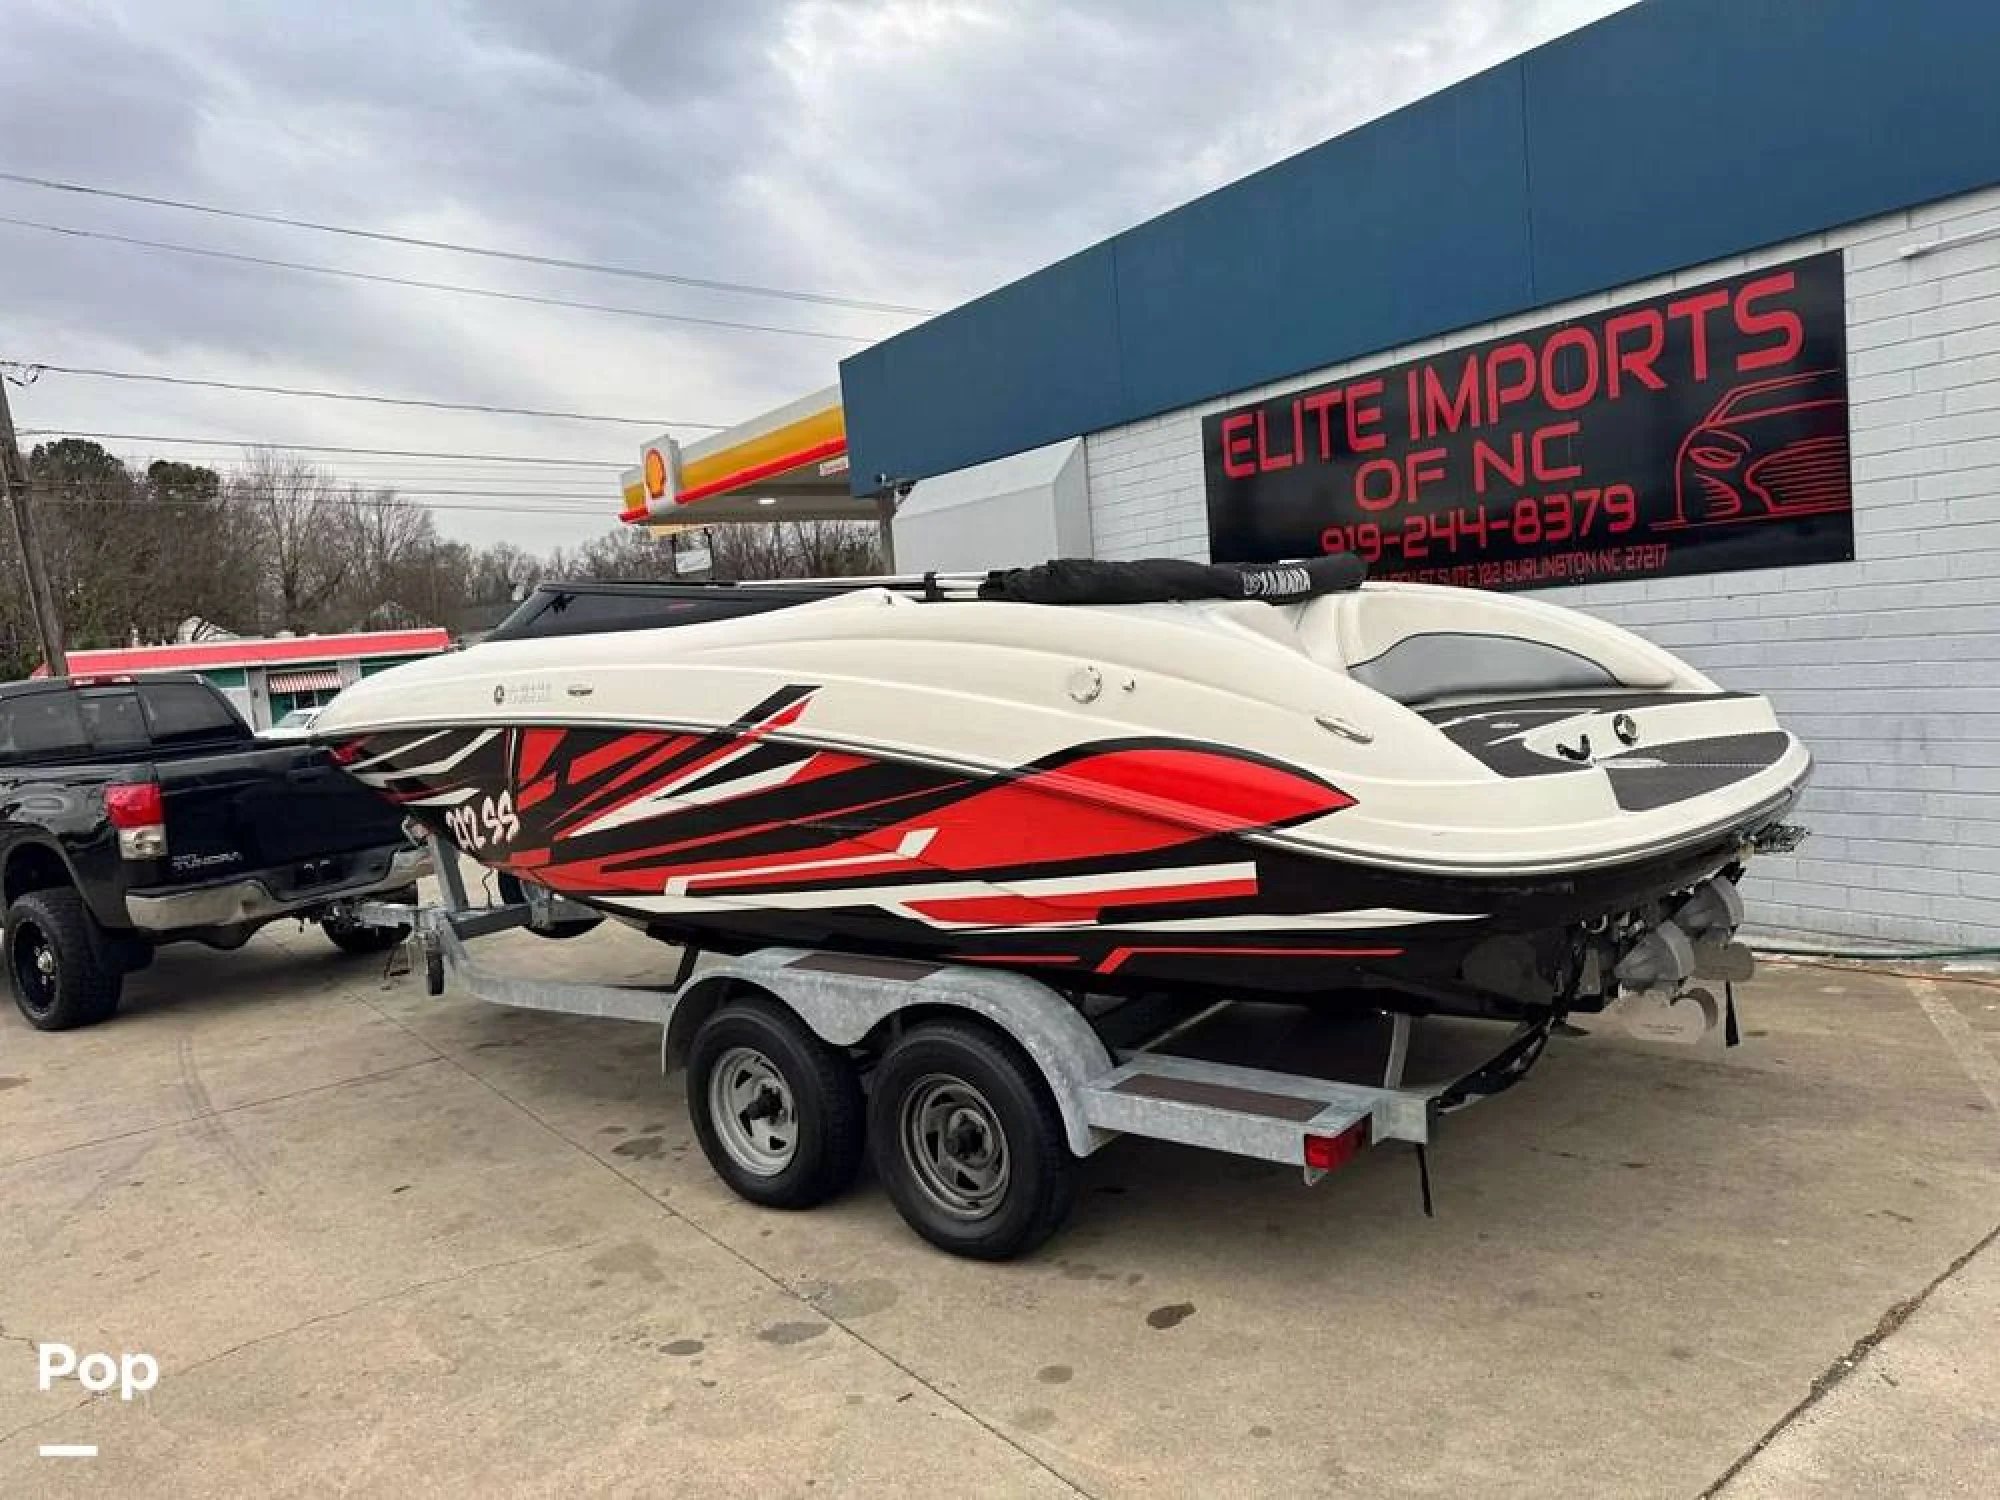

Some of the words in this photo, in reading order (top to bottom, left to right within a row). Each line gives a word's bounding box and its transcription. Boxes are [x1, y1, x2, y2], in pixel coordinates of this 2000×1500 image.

[1223, 379, 1387, 478] ELITE
[1406, 271, 1803, 441] IMPORTS
[1355, 448, 1447, 511] OF
[1473, 420, 1583, 493] NC
[1321, 484, 1636, 561] 919-244-8379
[1503, 551, 1597, 582] BURLINGTON
[1599, 547, 1621, 571] NC
[1625, 543, 1667, 571] 27217
[482, 789, 520, 845] SS
